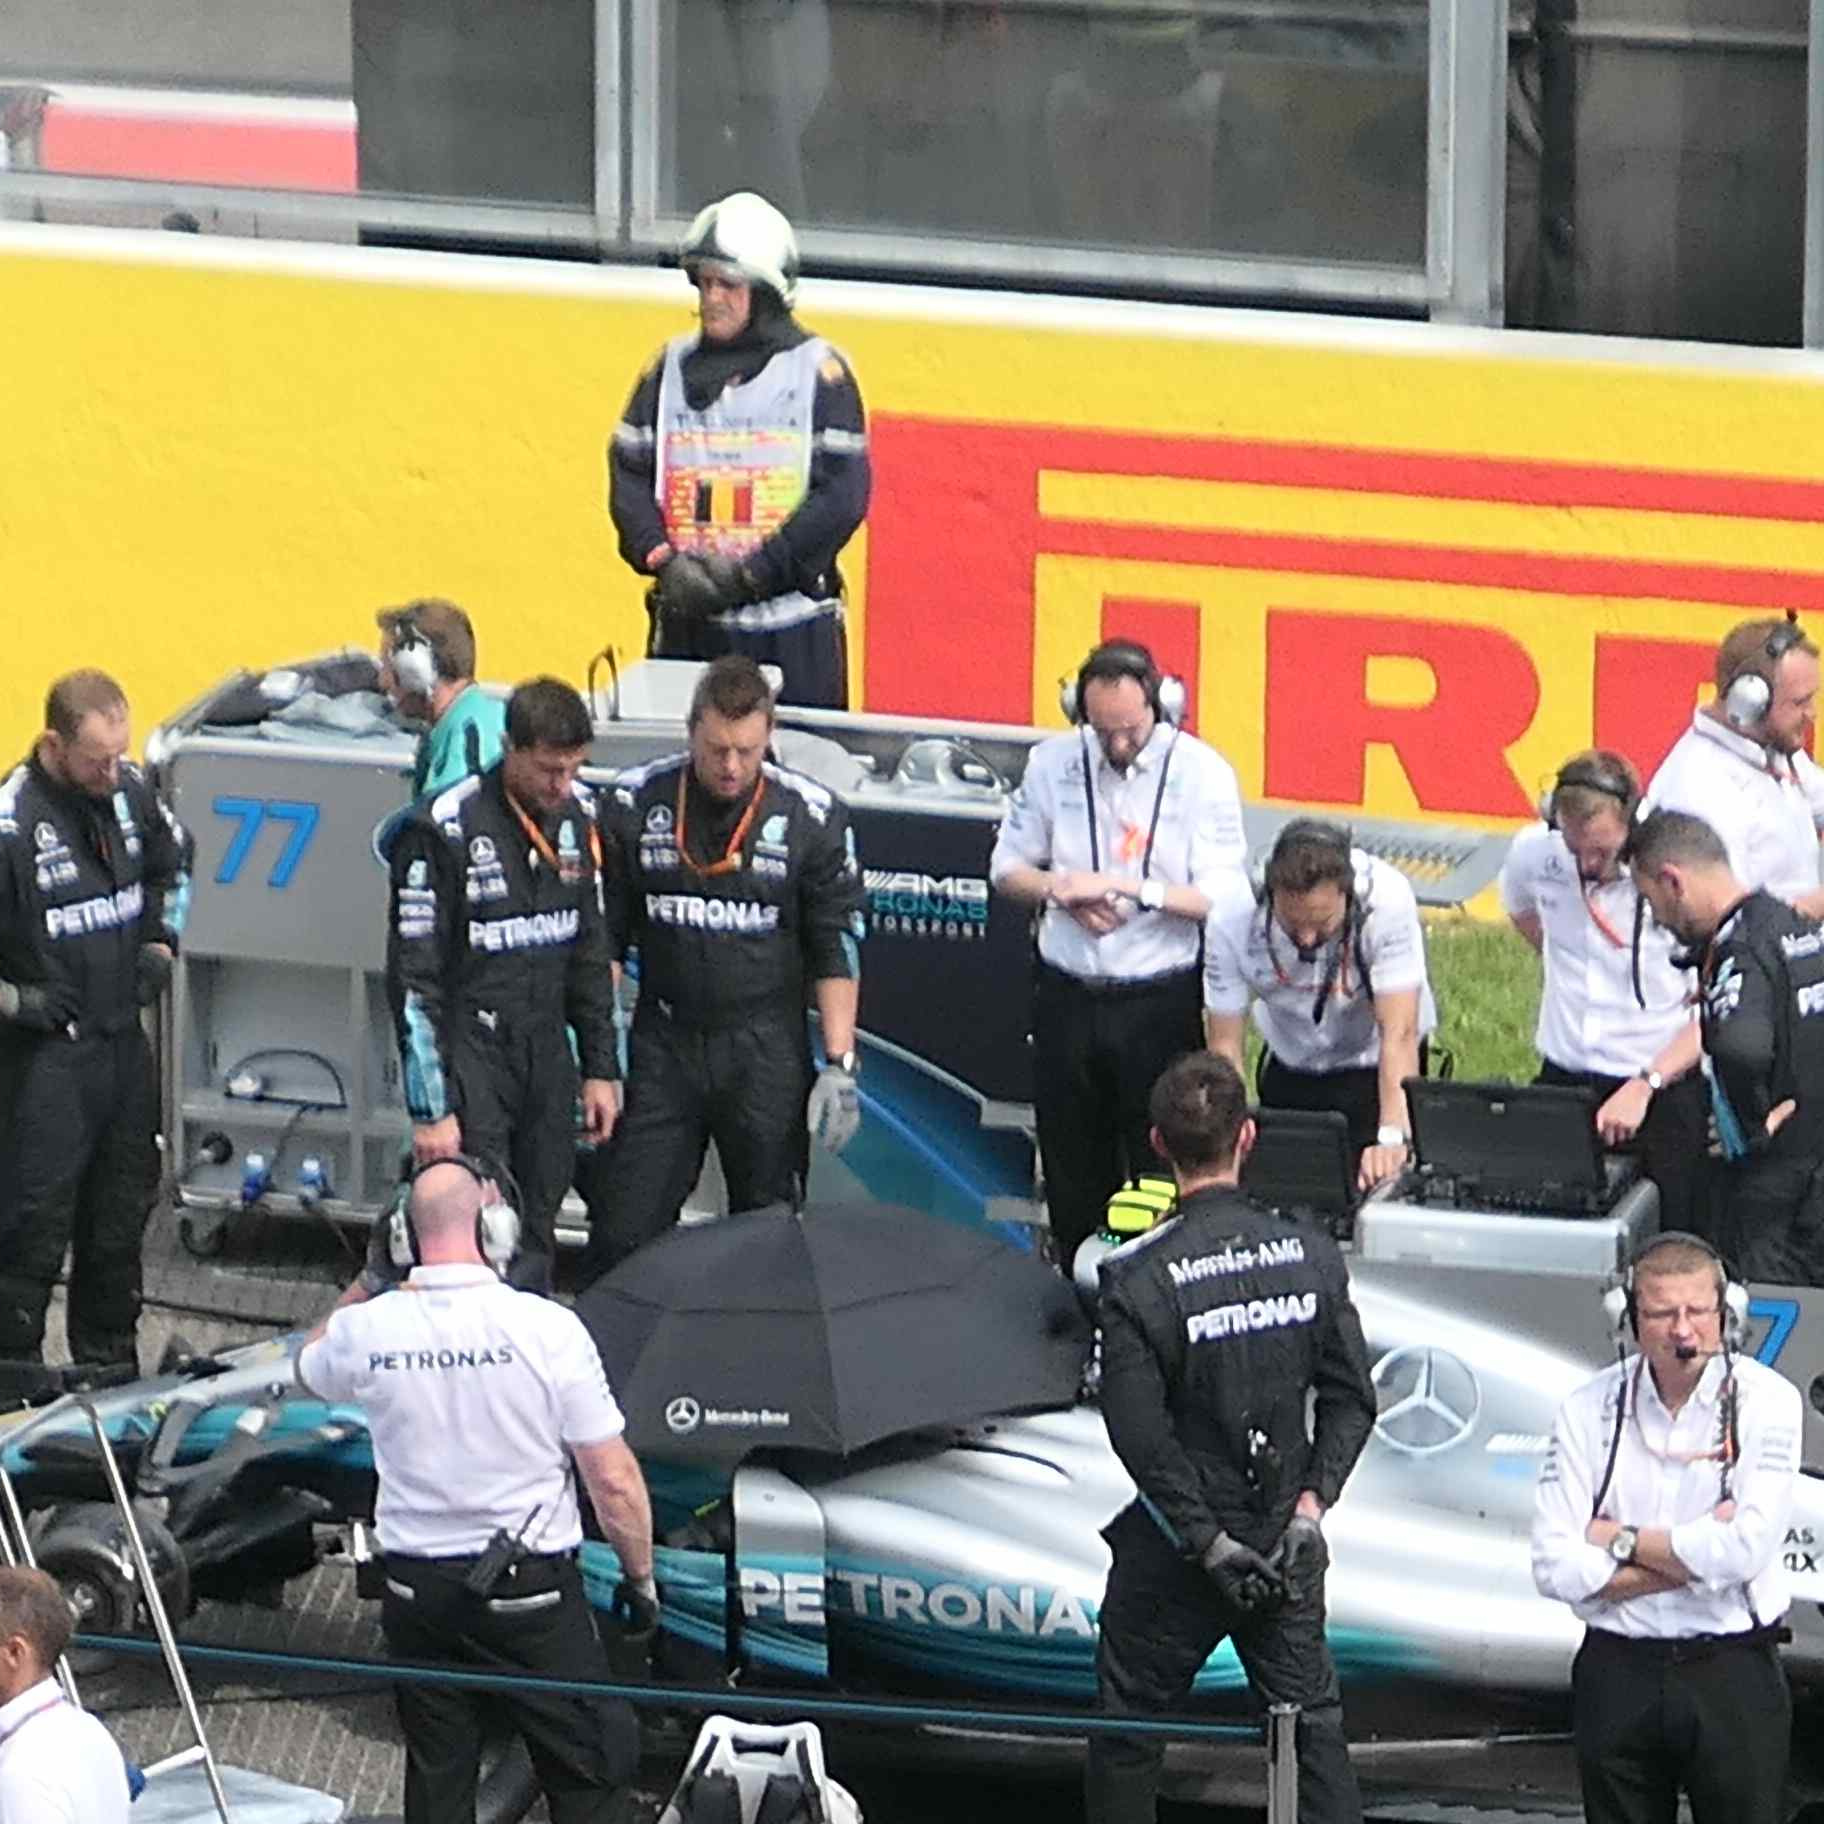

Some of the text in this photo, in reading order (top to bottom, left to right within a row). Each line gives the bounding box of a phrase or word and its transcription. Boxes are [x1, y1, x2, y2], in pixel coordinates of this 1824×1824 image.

[212, 795, 320, 889] 77
[645, 893, 781, 929] PETRONAS
[870, 891, 989, 919] RONAS
[872, 918, 987, 940] TORSPORT
[1187, 1293, 1318, 1344] PETRONAS
[368, 1346, 514, 1370] PETRONAS
[739, 1566, 1098, 1637] PETRONA
